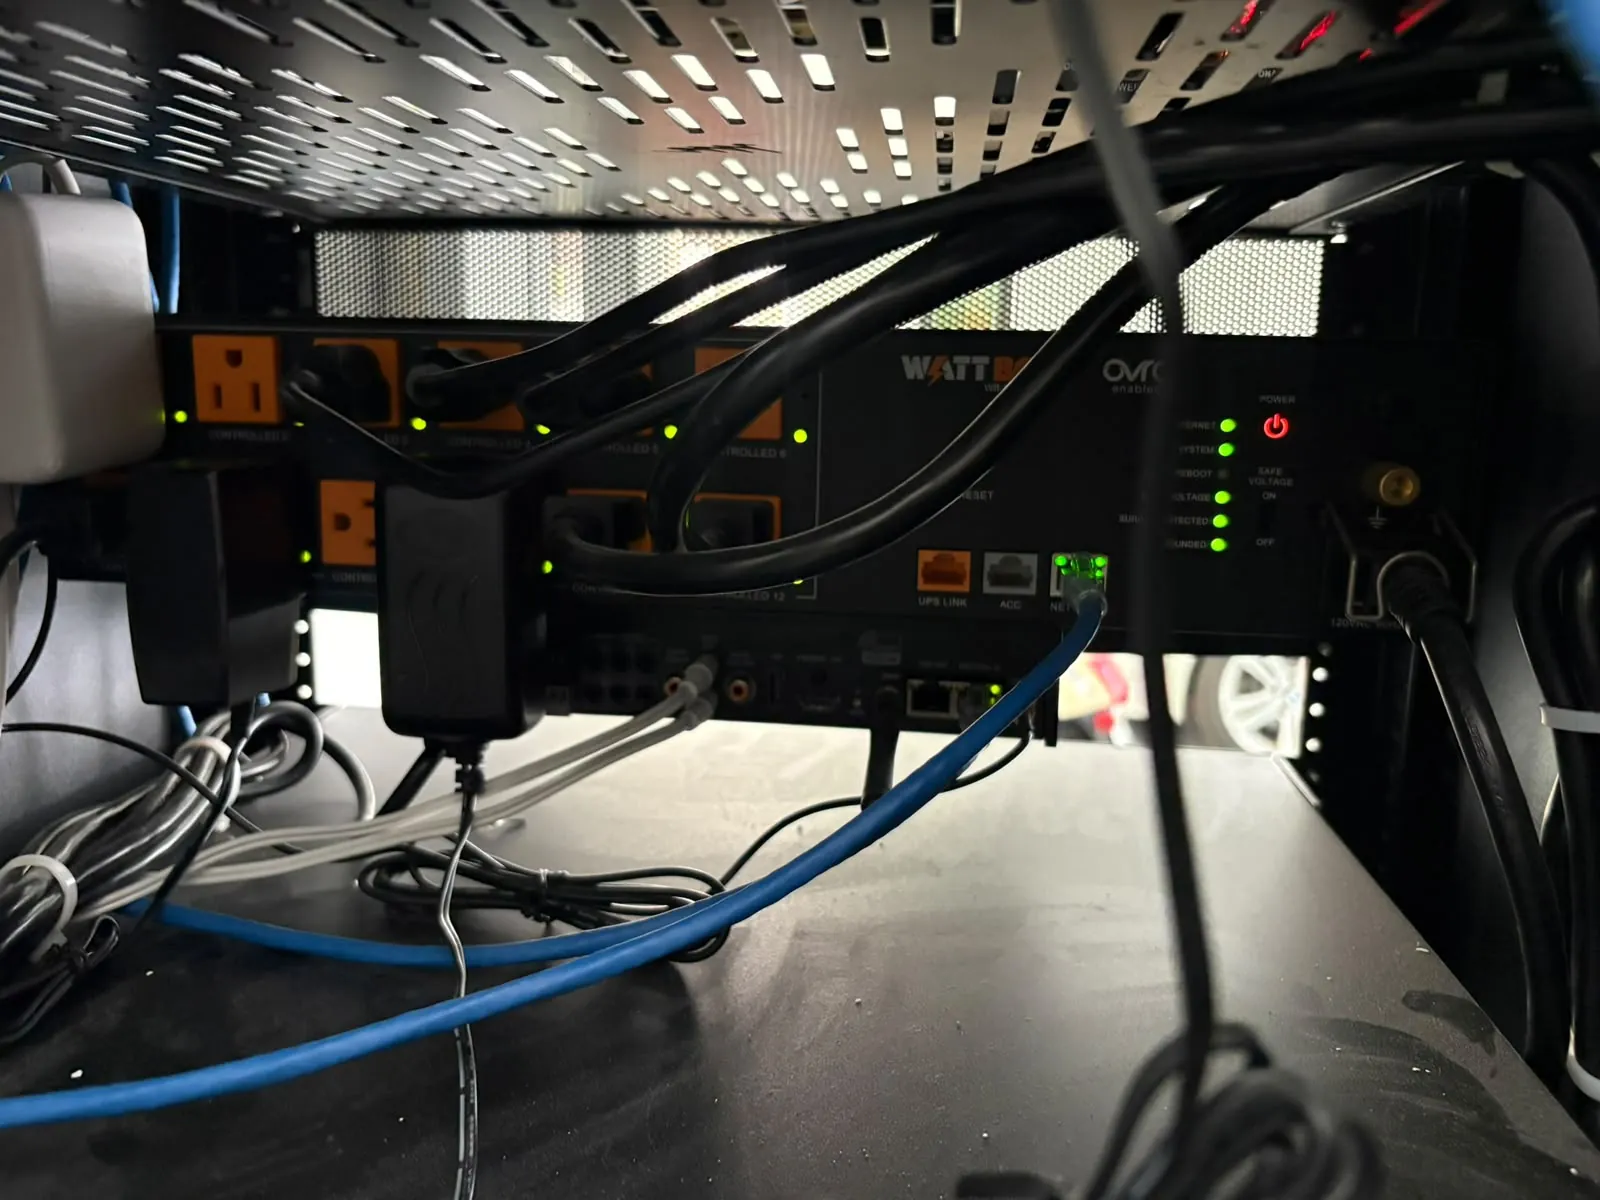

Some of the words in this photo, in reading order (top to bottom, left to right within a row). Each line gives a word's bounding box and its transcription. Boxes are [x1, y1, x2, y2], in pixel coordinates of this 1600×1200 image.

[1258, 395, 1295, 405] POWER
[1257, 467, 1283, 477] SAFE
[1248, 477, 1294, 488] VOLTAGE
[1261, 491, 1277, 501] ON
[1255, 537, 1275, 547] OFF
[918, 596, 940, 607] UPS
[942, 597, 968, 608] LINK
[999, 599, 1022, 610] ACC
